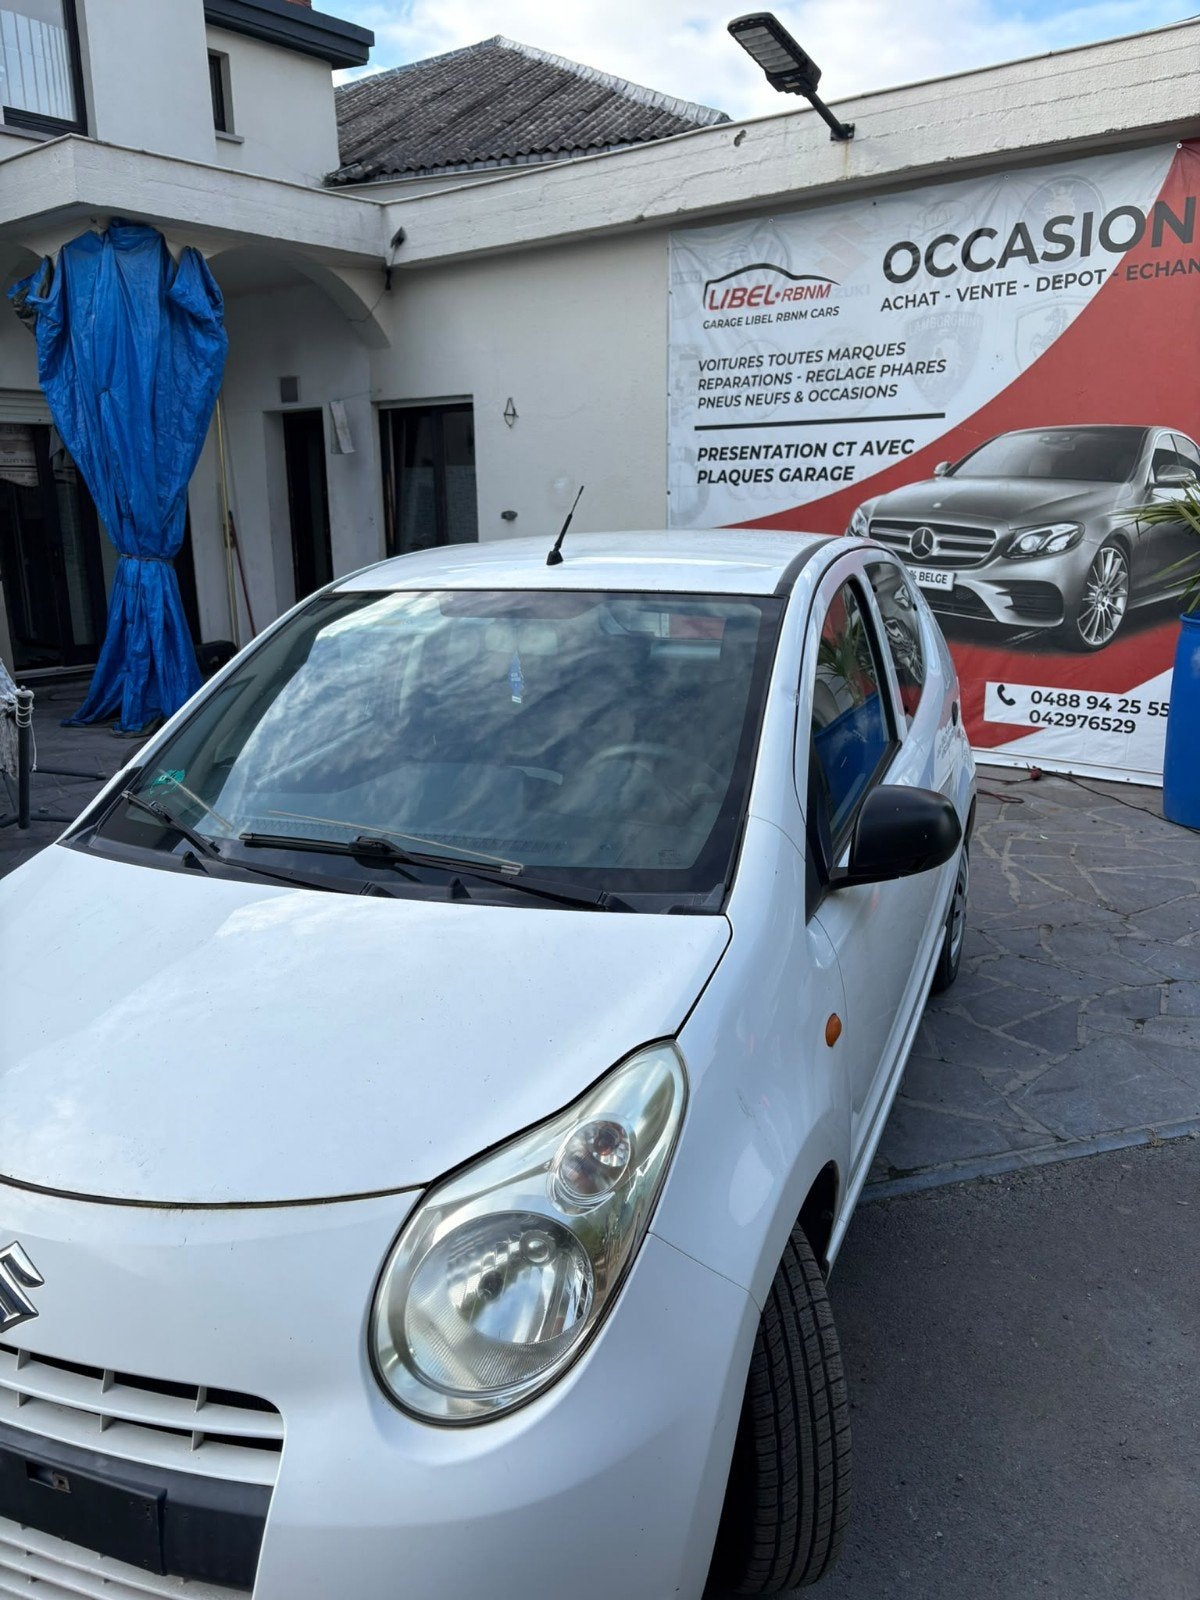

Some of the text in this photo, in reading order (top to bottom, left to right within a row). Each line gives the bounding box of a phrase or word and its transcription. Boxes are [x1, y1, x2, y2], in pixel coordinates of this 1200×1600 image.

[883, 196, 1196, 284] OCCASION
[880, 291, 940, 311] ACHAT
[957, 281, 1018, 301] VENTE
[1036, 268, 1107, 292] DEPOT
[1126, 258, 1200, 281] ECHAN
[703, 306, 840, 329] GARAGE LIBEL RBNM CARS
[698, 342, 906, 372] VOITURES TOUTES MARQUES
[698, 372, 792, 390] REPARATIONS
[805, 366, 876, 383] REGLAGE
[880, 359, 947, 377] PHARES
[698, 384, 898, 409] PNEUS NEUFS & OCCASIONS
[697, 439, 915, 462] PRESENTATION CT AVEC
[697, 466, 855, 486] PLAQUES GARAGE
[919, 572, 948, 584] BELGE
[1031, 691, 1170, 718] 0488 94 25 55
[1029, 710, 1136, 734] 042976529
